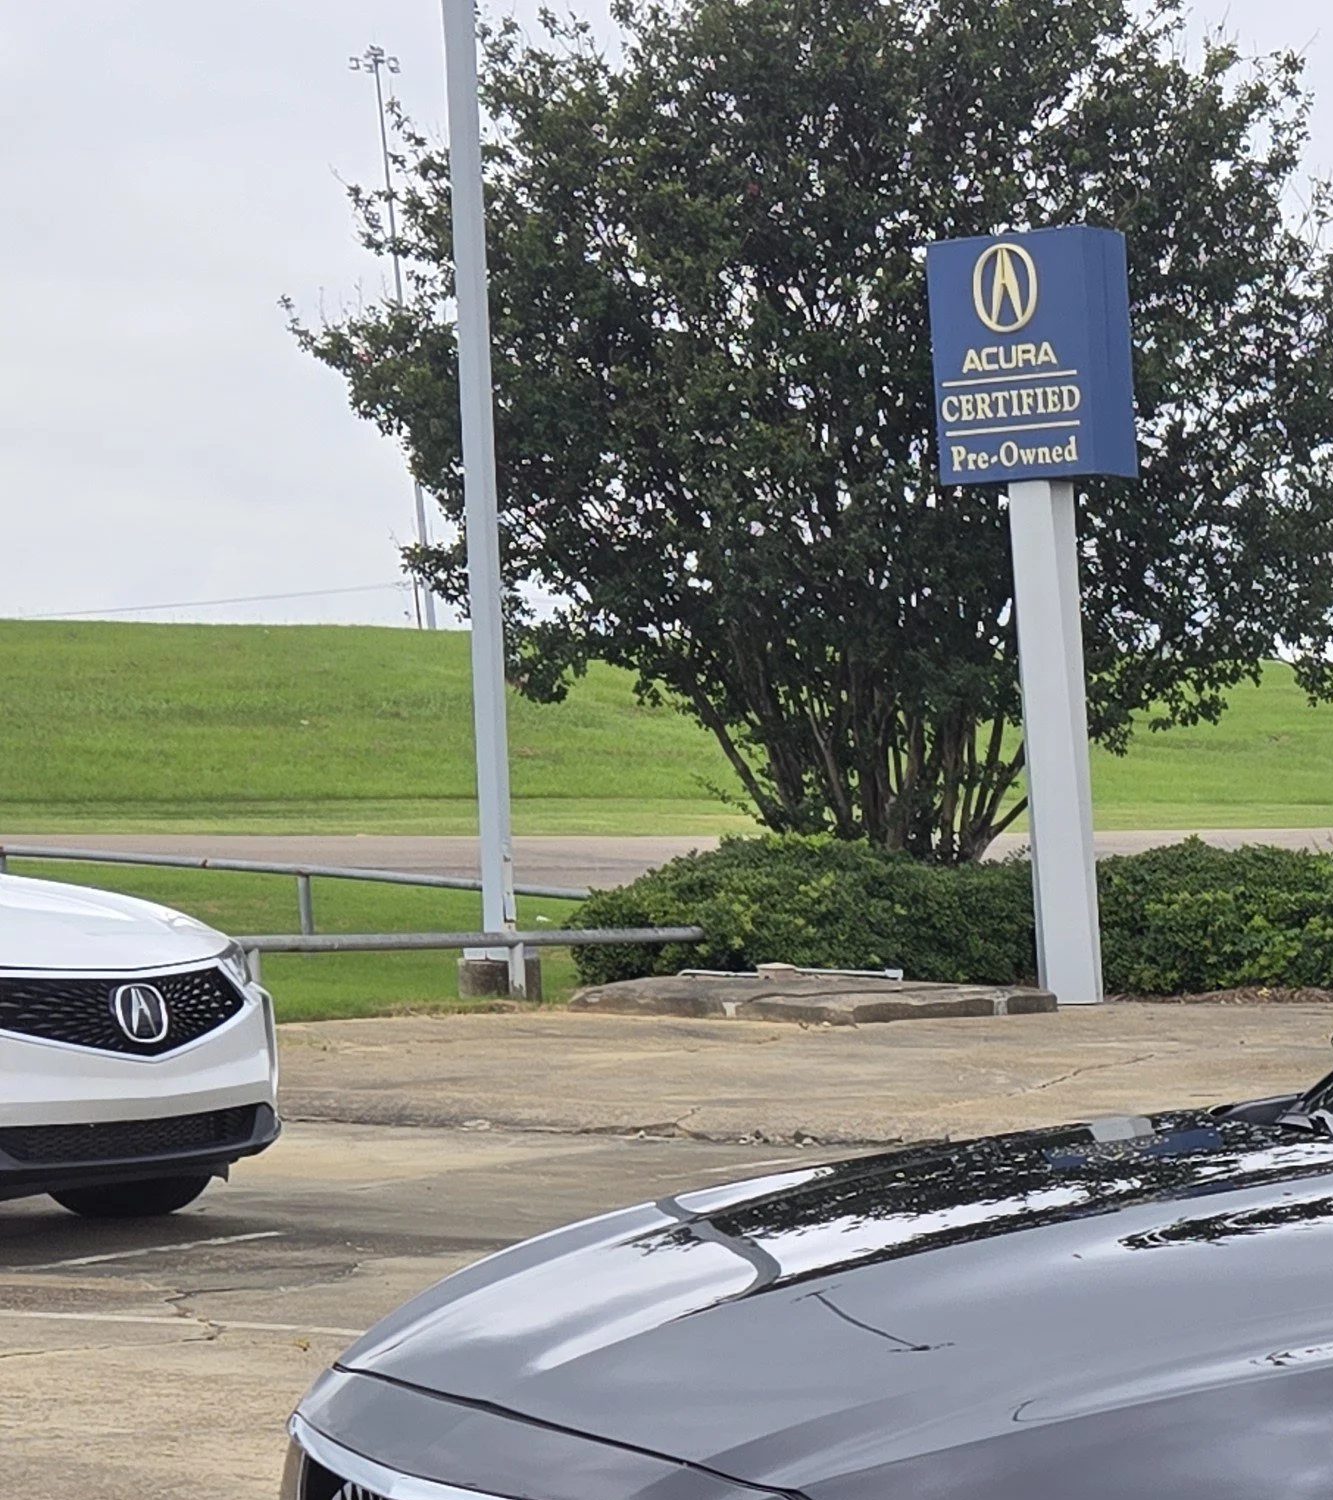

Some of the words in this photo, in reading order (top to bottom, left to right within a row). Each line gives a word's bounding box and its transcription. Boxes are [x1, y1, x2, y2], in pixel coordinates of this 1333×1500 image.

[962, 341, 1057, 373] ACURA
[942, 385, 1080, 422] CERTIFIED
[951, 436, 1078, 472] Pre-Owned
